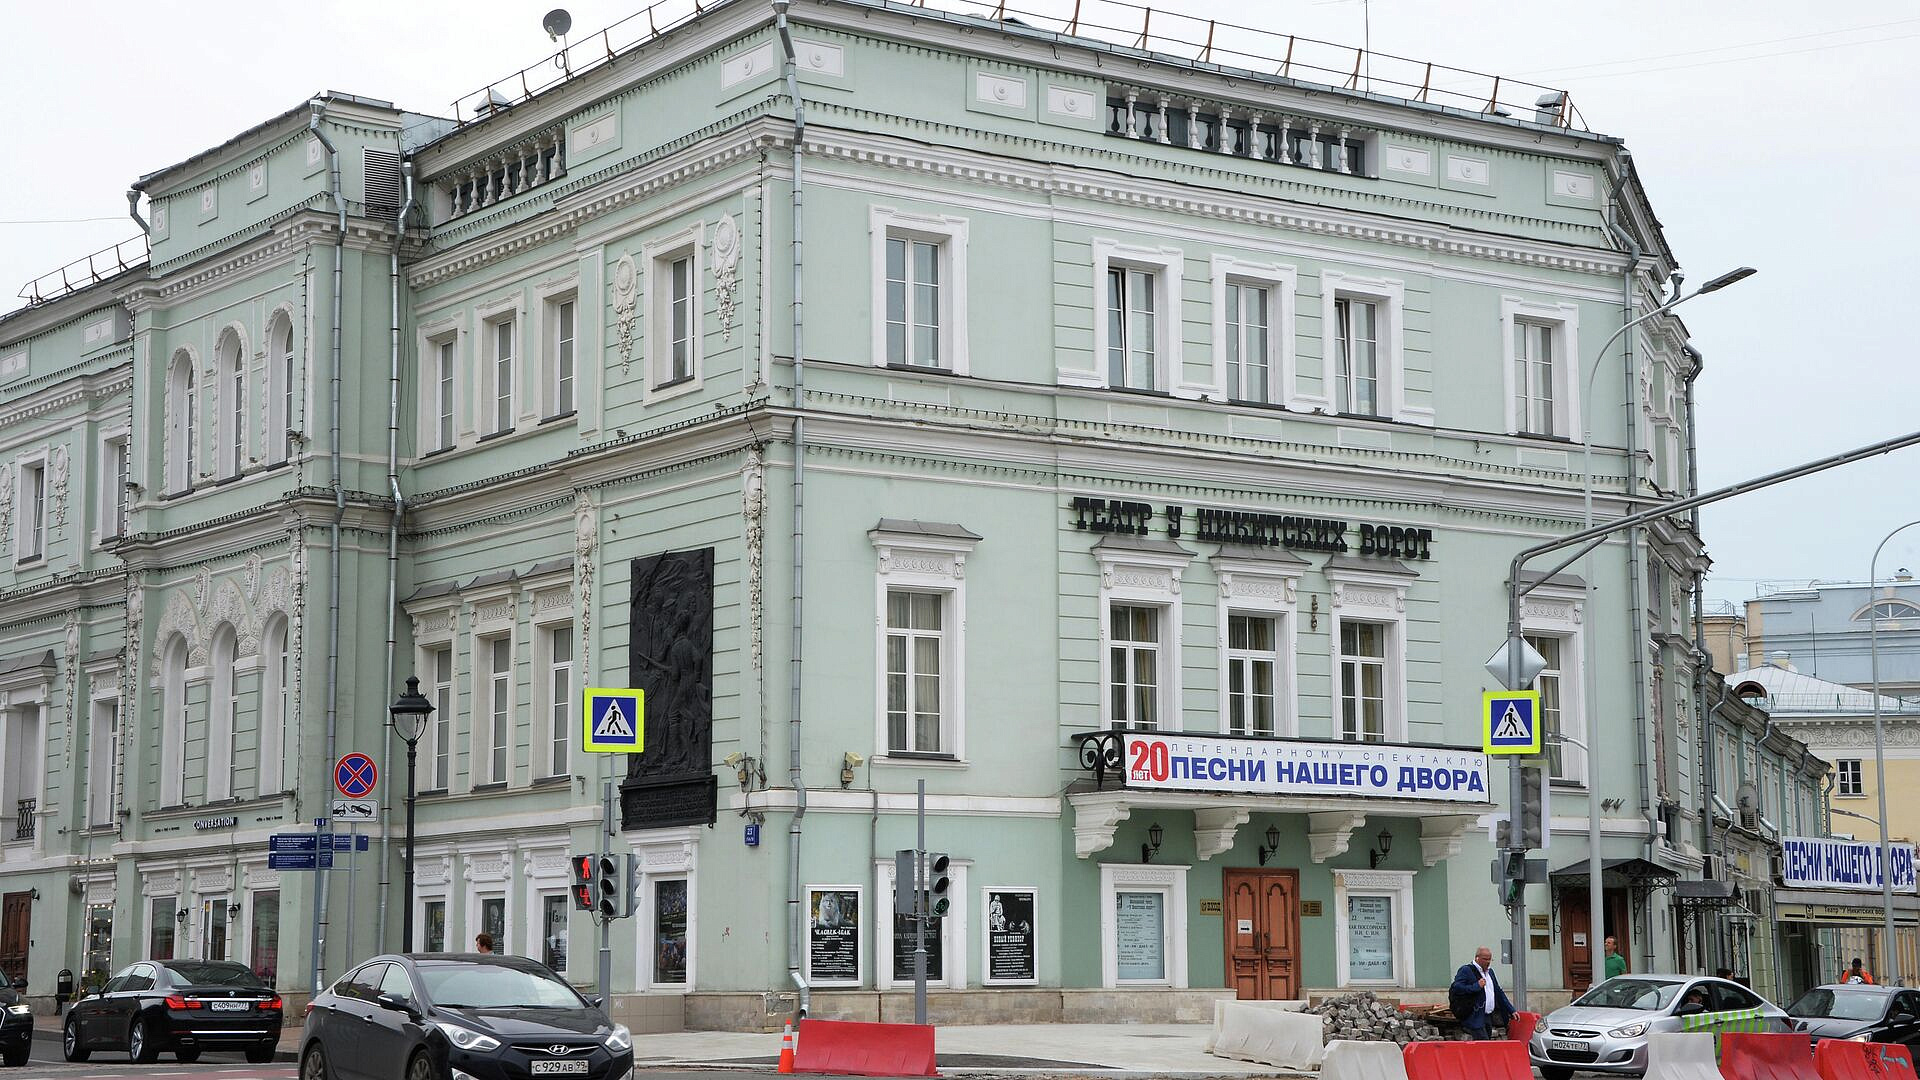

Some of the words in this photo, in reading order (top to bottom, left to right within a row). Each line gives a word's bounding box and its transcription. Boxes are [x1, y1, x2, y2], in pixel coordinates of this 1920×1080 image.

[1073, 497, 1152, 536] ТЕАТР
[1166, 505, 1182, 538] У
[1197, 508, 1348, 552] НИКИТСКИХ
[1360, 523, 1432, 560] ВОРОТ
[1130, 740, 1169, 782] 20
[1171, 743, 1344, 760] ЛЕГЕНДАРНОМУ
[1363, 752, 1483, 767] СПЕКТАКЛЮ
[1132, 769, 1150, 781] лет
[1171, 756, 1266, 782] ПЕСНИ
[1276, 760, 1388, 787] НАШЕГО
[1397, 766, 1485, 792] ДВОРА
[194, 817, 236, 830] CONVERSATION
[1785, 841, 1822, 881] ПЕСНИ
[1825, 844, 1872, 885] НАШЕГО
[1876, 847, 1914, 887] ДОРА
[1824, 906, 1838, 915] Театр
